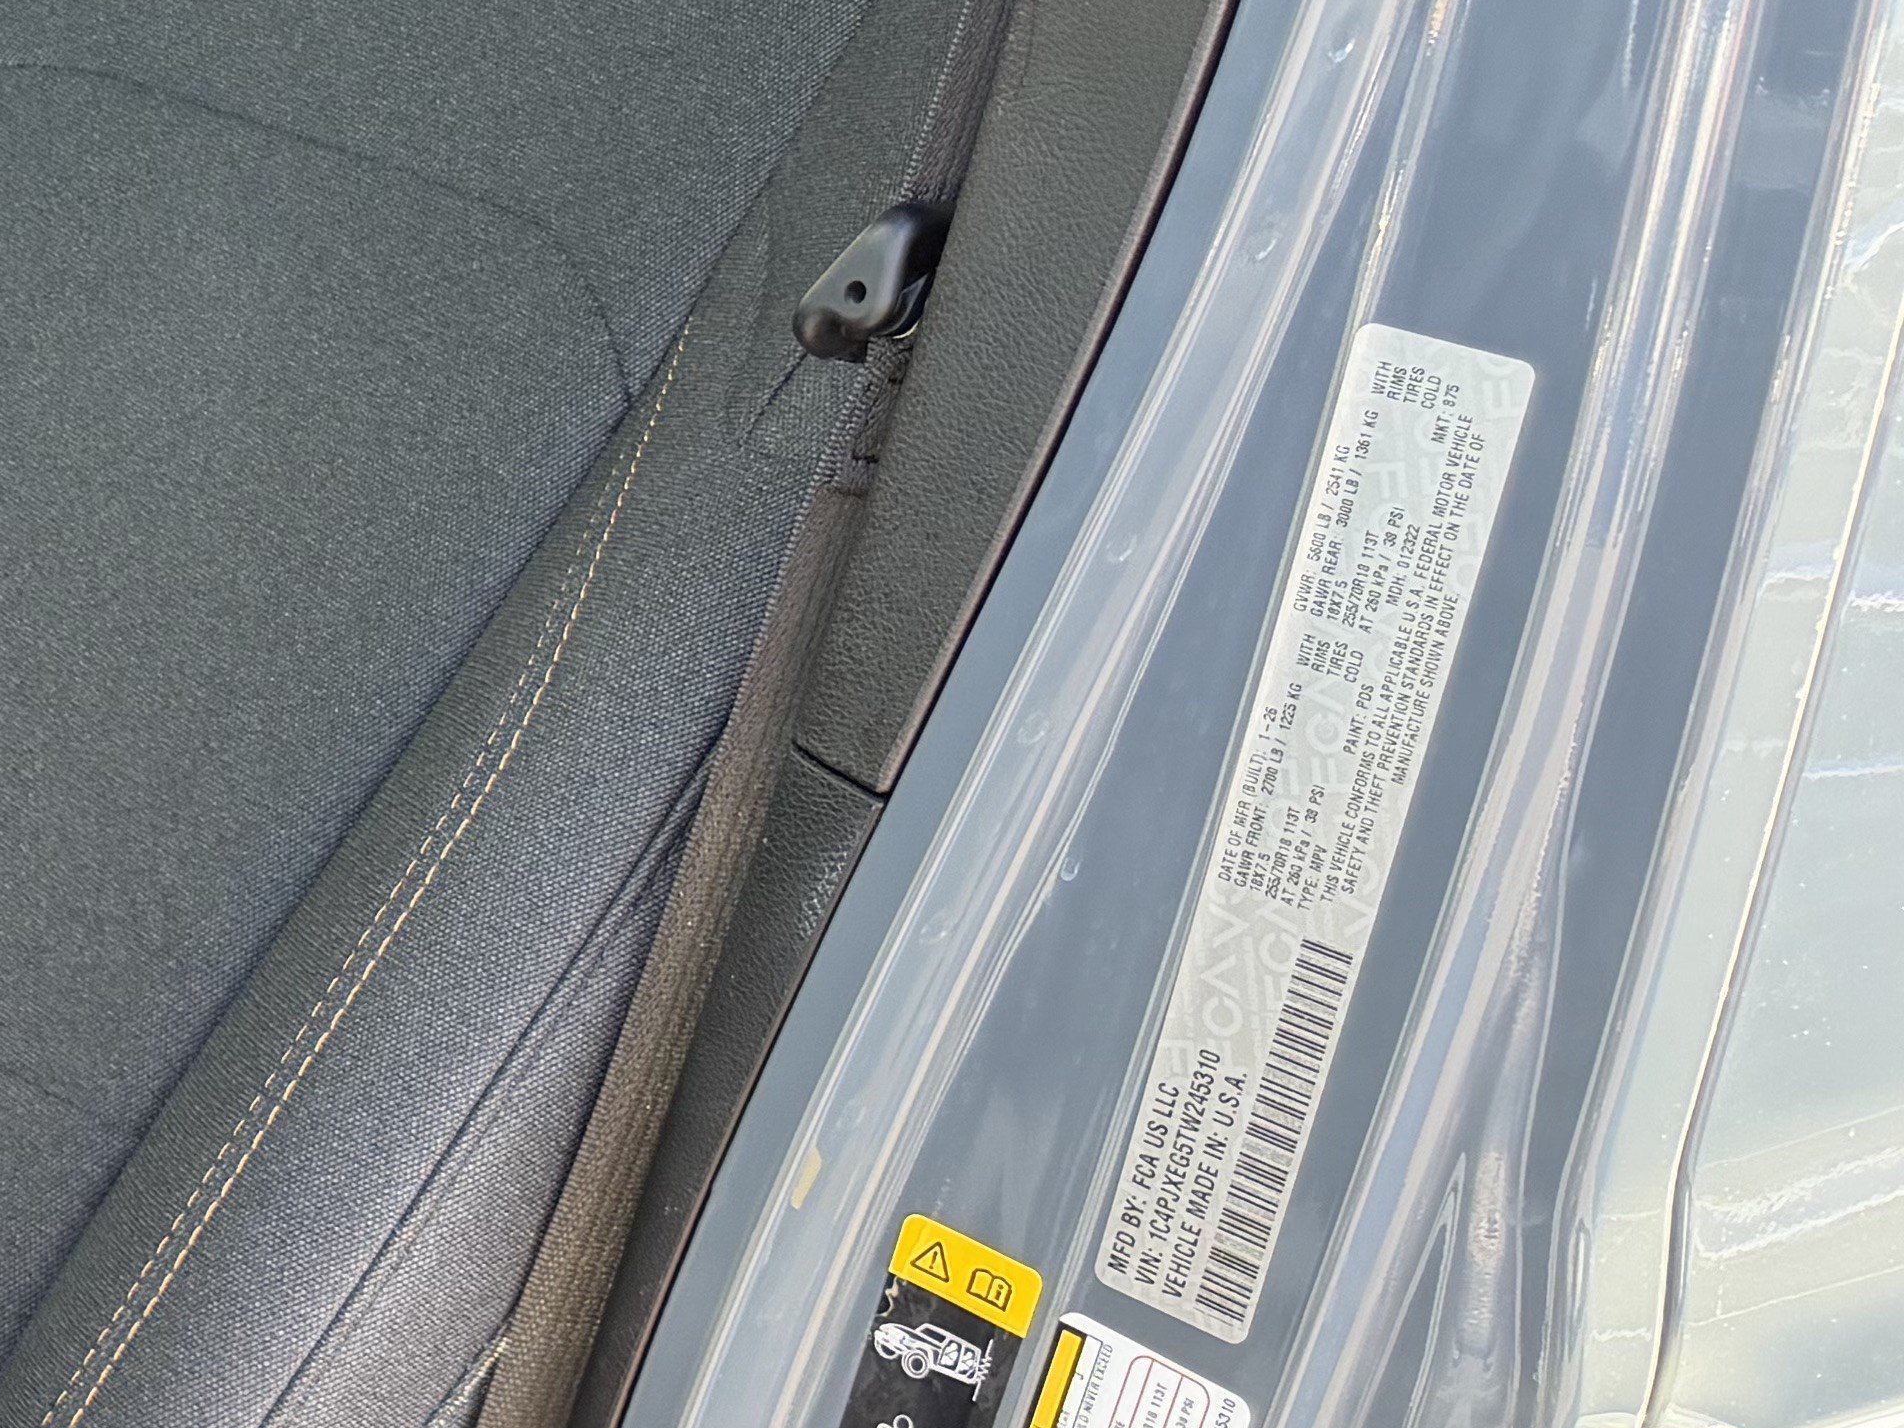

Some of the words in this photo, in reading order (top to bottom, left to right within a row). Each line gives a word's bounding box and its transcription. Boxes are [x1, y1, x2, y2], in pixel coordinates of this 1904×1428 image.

[1370, 360, 1392, 395] WITH
[1420, 374, 1443, 409] COLD
[1441, 382, 1461, 407] 875
[1361, 409, 1379, 428] KG
[1431, 409, 1453, 443] MKT:
[1333, 444, 1351, 463] KG
[1352, 431, 1372, 460] 1361
[1444, 413, 1473, 468] VEHICLE
[1468, 432, 1486, 451] OF
[1324, 466, 1345, 496] 2541
[1343, 477, 1359, 494] LB
[1348, 468, 1362, 476] /
[1457, 453, 1480, 489] DATE
[1320, 502, 1334, 510] /
[1325, 578, 1348, 621] 18X7.5
[1386, 365, 1408, 400] RIMS
[1340, 562, 1371, 628] 255/70R18
[1359, 529, 1380, 559] 113T
[1403, 365, 1426, 405] TIRES
[1430, 471, 1456, 517] MOTOR
[1448, 492, 1469, 519] THE
[1315, 512, 1332, 529] LB
[1333, 496, 1354, 528] 3000
[1386, 505, 1405, 528] PSI
[1442, 521, 1460, 541] ON
[1320, 534, 1344, 575] REAR:
[1377, 553, 1391, 561] /
[1385, 571, 1407, 606] MDH:
[1396, 523, 1421, 569] 012322
[1413, 519, 1442, 579] FEDERAL
[1370, 562, 1389, 587] kPa
[1427, 543, 1454, 592] EFFECT
[1292, 568, 1316, 612] GVWR:
[1308, 577, 1332, 618] GAWR
[1422, 594, 1439, 610] IN
[1357, 614, 1374, 634] AT
[1294, 632, 1315, 667] WITH
[1342, 648, 1364, 683] COLD
[1377, 624, 1412, 702] APPLICABLE
[1399, 611, 1434, 690] STANDARDS
[1285, 681, 1302, 700] KG
[1390, 689, 1431, 785] MANUFACTURE
[1419, 639, 1446, 688] SHOWN
[1434, 590, 1460, 637] ABOVE.
[1342, 711, 1366, 755] PAINT:
[1355, 681, 1375, 709] PDS
[1370, 702, 1389, 728] ALL
[1376, 691, 1411, 771] PREVENTION
[1268, 746, 1283, 763] LB
[1273, 737, 1286, 745] /
[1364, 729, 1381, 748] TO
[1248, 851, 1271, 893] 18X7.5
[1310, 638, 1330, 672] RIMS
[1259, 765, 1278, 795] 2700
[1263, 836, 1292, 899] 255/70R18
[1281, 805, 1301, 835] 113T
[1325, 639, 1348, 678] TIRES
[1307, 783, 1325, 806] PSI
[1344, 749, 1376, 819] CONFORMS
[1363, 773, 1387, 815] THEFT
[1232, 798, 1252, 828] MFR
[1244, 800, 1268, 847] FRONT:
[1354, 815, 1374, 844] AND
[1227, 829, 1243, 847] OF
[1292, 837, 1310, 862] kPa
[1299, 828, 1312, 837] /
[1329, 819, 1355, 873] VEHICLE
[1217, 847, 1238, 882] DATE
[1233, 848, 1255, 888] GAWR
[1297, 874, 1319, 912] TYPE:
[1308, 844, 1328, 872] MPV
[1340, 846, 1366, 895] SAFETY
[1279, 887, 1296, 906] AT
[1319, 873, 1340, 904] THIS
[1151, 1080, 1179, 1119] LLC
[1211, 1065, 1247, 1129] U.S.A.
[1142, 1118, 1168, 1150] US
[1147, 1047, 1220, 1245] 1C4PJXEG5TW245310
[1202, 1128, 1228, 1161] IN:
[1131, 1149, 1159, 1191] FCA
[1185, 1161, 1219, 1220] MADE
[1120, 1192, 1147, 1229] BY:
[1107, 1228, 1136, 1275] MFD
[1135, 1244, 1164, 1288] VIN:
[1162, 1219, 1202, 1301] VEHICLE
[1080, 1379, 1100, 1413] NEVER
[1091, 1341, 1113, 1381] EXCEED
